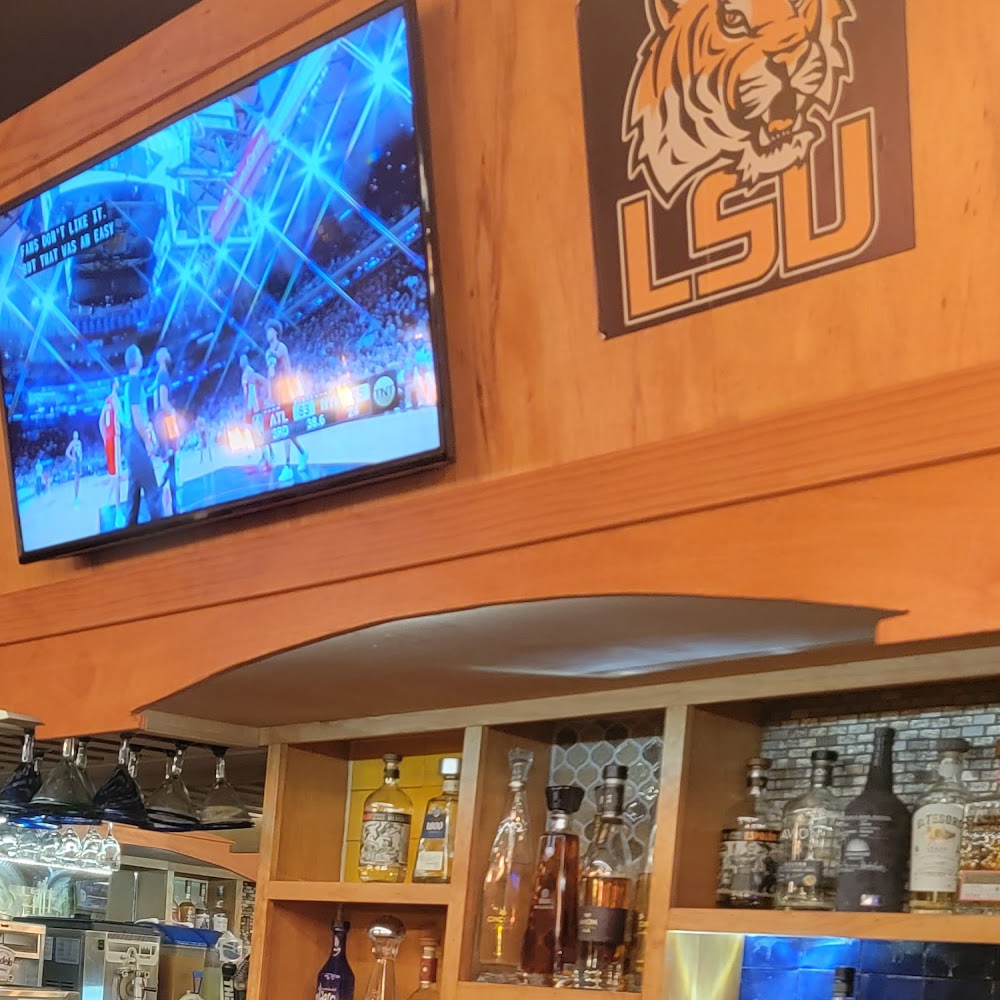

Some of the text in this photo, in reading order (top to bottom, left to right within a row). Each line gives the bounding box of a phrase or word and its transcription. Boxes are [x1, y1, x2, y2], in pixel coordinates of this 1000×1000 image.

[21, 238, 40, 258] FANS
[41, 224, 66, 249] DON'T
[68, 213, 89, 236] LIKE
[616, 107, 880, 327] LSU
[40, 247, 59, 269] THAT
[61, 239, 77, 258] WAS
[93, 220, 115, 244] EASY
[374, 384, 396, 400] TNT
[269, 410, 289, 427] ATL
